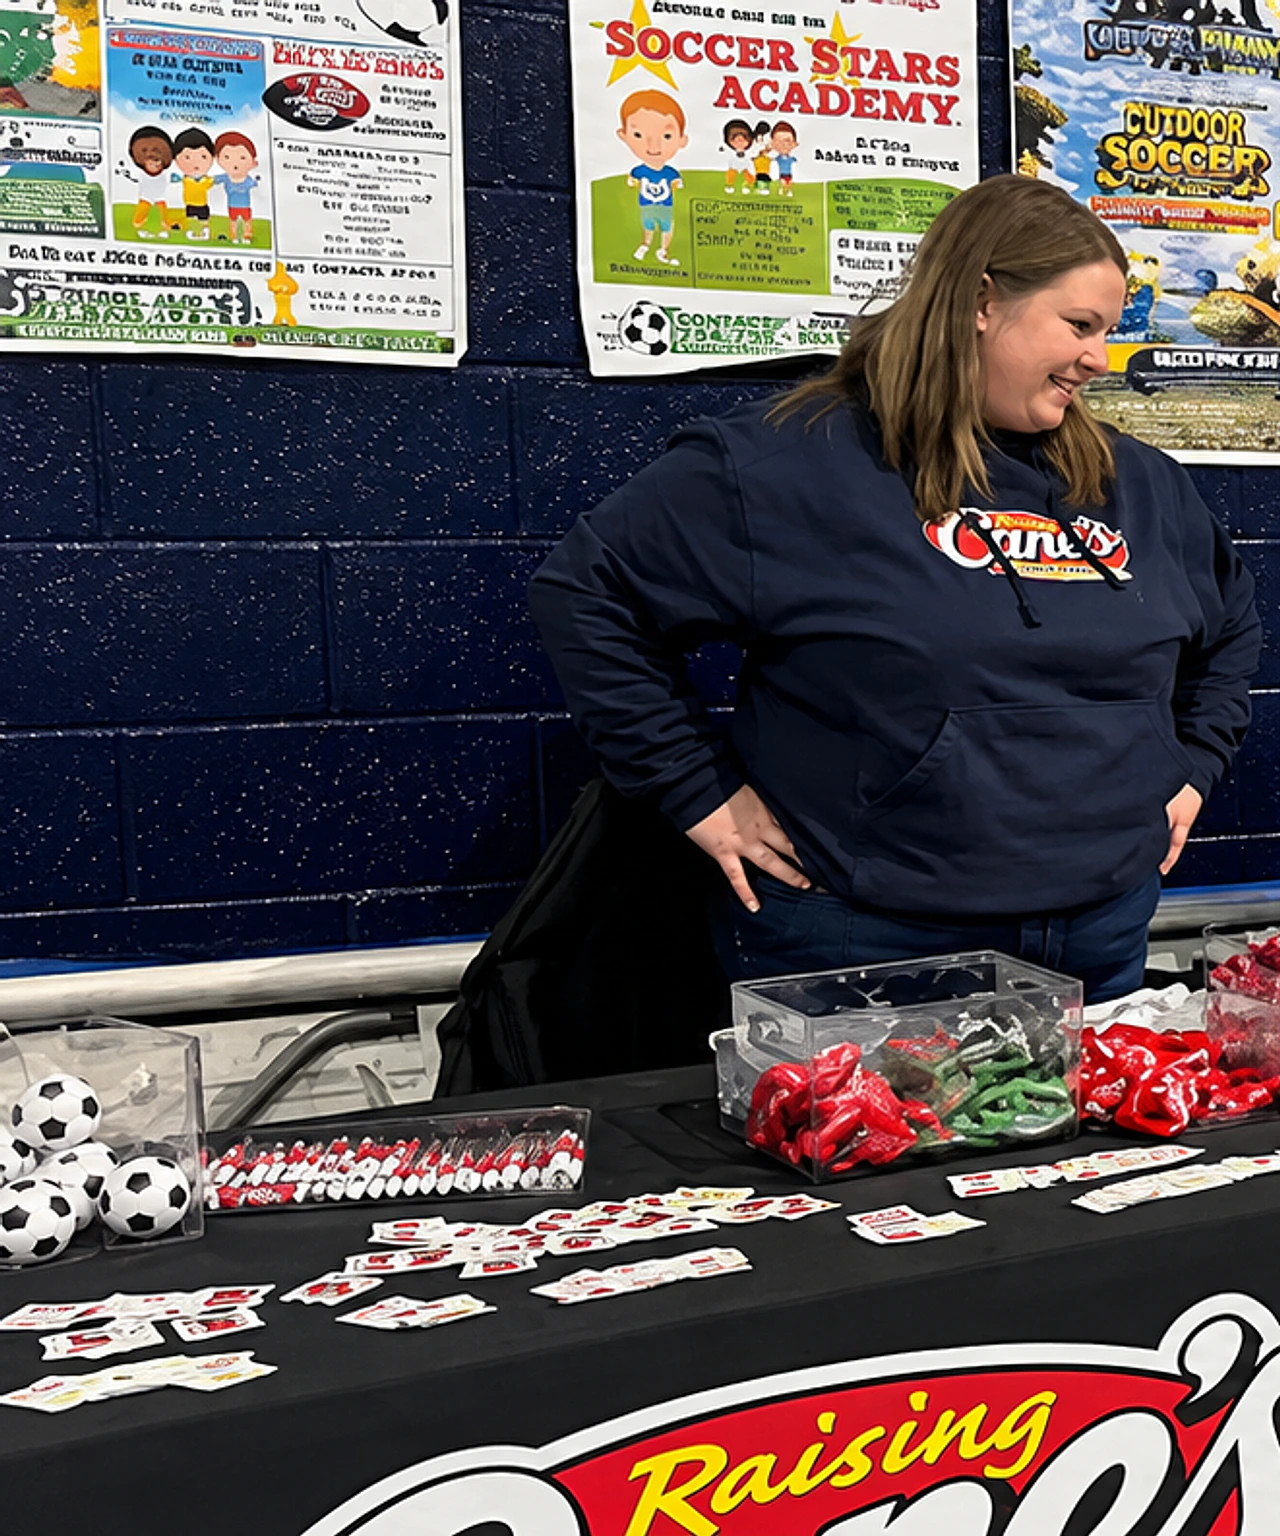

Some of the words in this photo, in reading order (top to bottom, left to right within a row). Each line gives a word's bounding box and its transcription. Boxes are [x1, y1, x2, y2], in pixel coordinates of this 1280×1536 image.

[605, 19, 799, 73] SOCCER
[810, 38, 962, 88] STARS
[1103, 134, 1258, 178] SOCCER
[627, 1390, 1057, 1536] Raising
